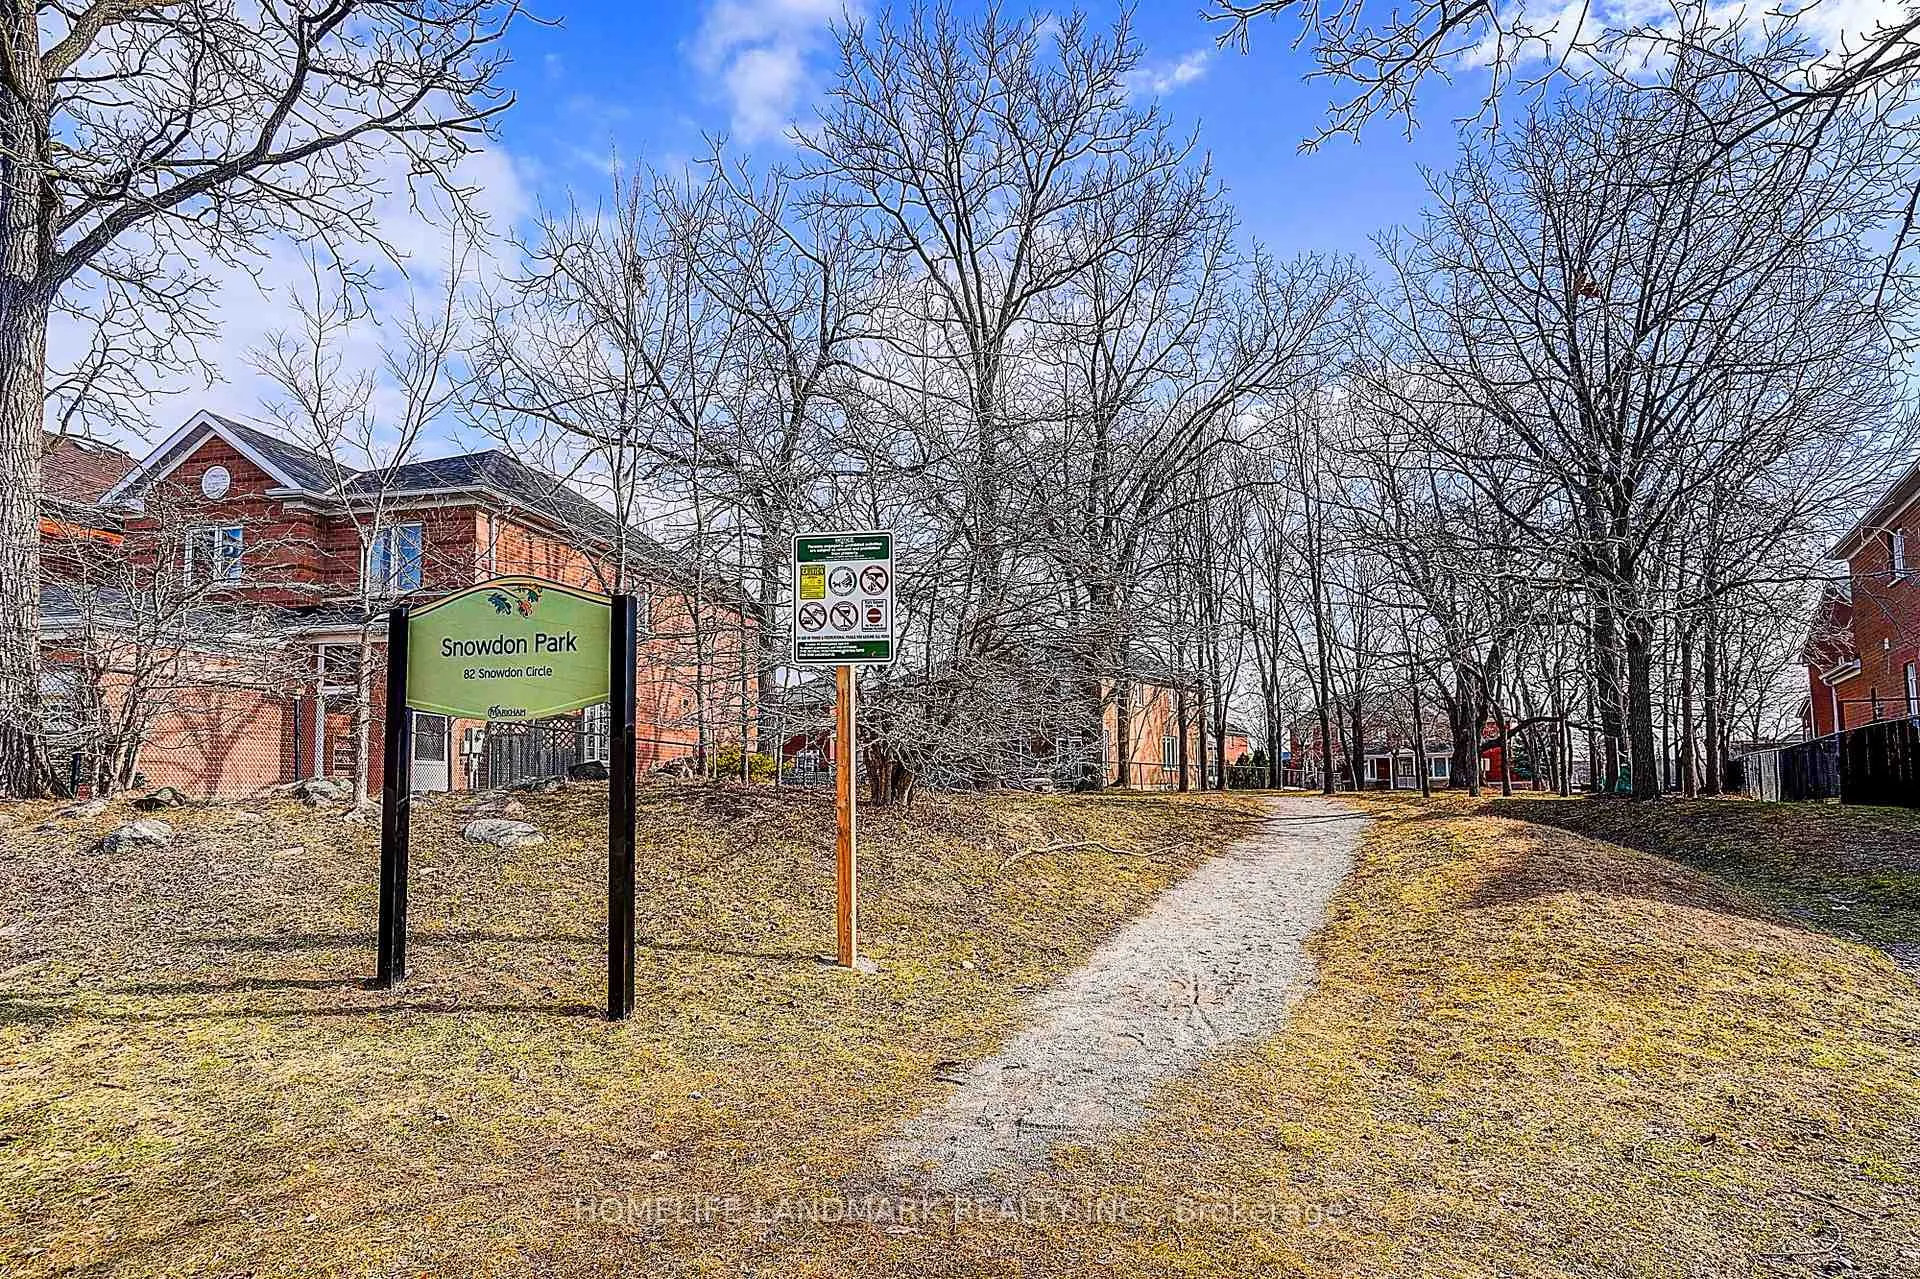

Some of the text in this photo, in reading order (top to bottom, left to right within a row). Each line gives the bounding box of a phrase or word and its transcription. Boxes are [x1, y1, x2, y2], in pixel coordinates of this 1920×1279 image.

[441, 631, 578, 657] Snowdon Park
[463, 666, 553, 679] 82 Snowdon Circle
